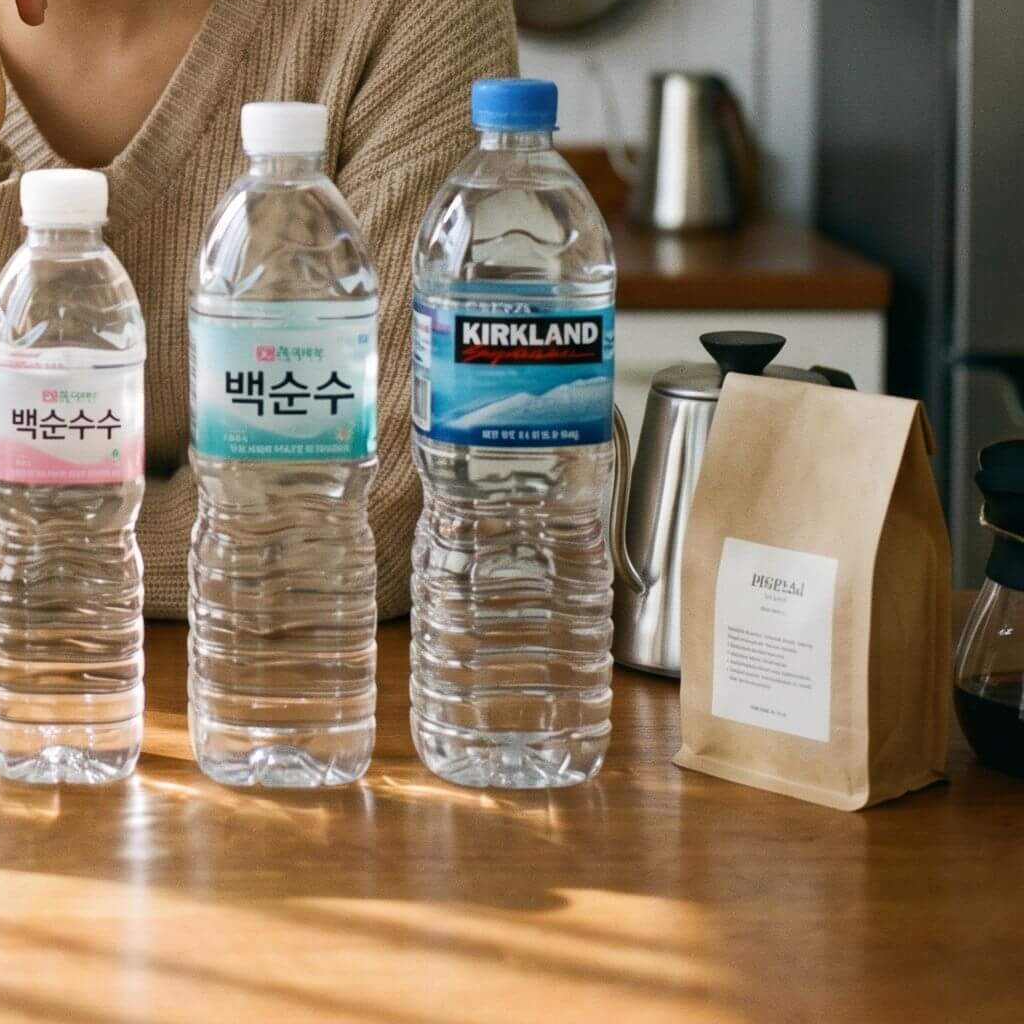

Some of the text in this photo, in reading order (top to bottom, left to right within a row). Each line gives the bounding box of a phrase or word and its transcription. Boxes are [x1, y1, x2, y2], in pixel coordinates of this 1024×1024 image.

[462, 322, 598, 346] KIRKLAND
[225, 370, 355, 416] 백순수
[12, 408, 122, 440] 백순수수
